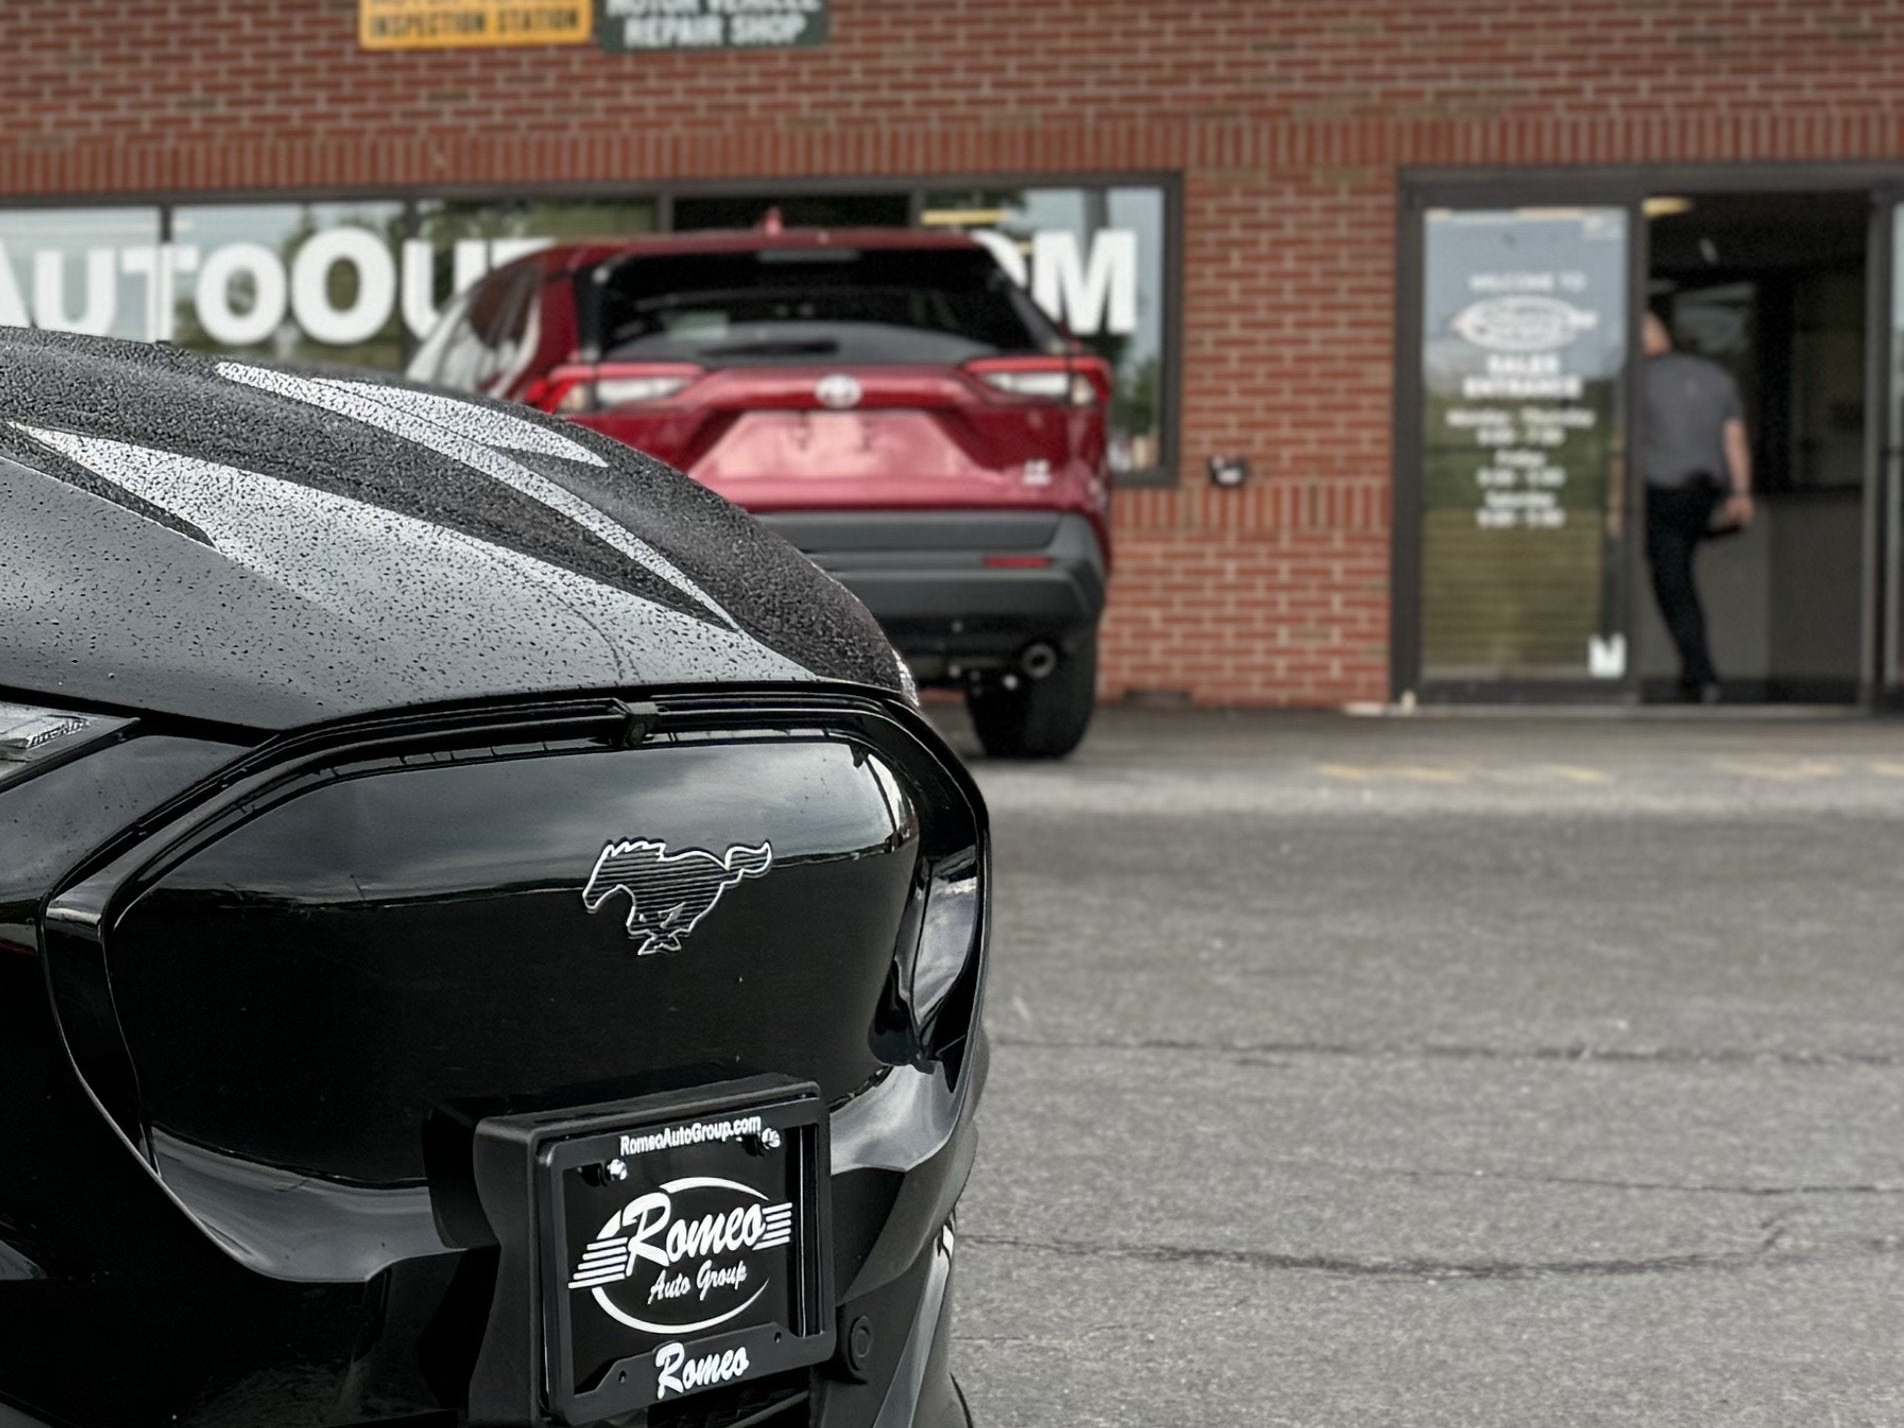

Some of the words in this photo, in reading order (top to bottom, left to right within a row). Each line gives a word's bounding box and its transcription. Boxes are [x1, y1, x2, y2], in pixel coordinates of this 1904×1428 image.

[371, 10, 486, 38] INSPECTION
[497, 7, 578, 33] STATION
[623, 15, 724, 48] REPAIR
[729, 13, 807, 45] SHOP
[620, 1115, 762, 1157] RomeoAutoGroup.com
[621, 1191, 767, 1277] Romeo
[647, 1269, 691, 1306] Auto
[695, 1259, 748, 1302] Group
[655, 1341, 750, 1400] Romeo
